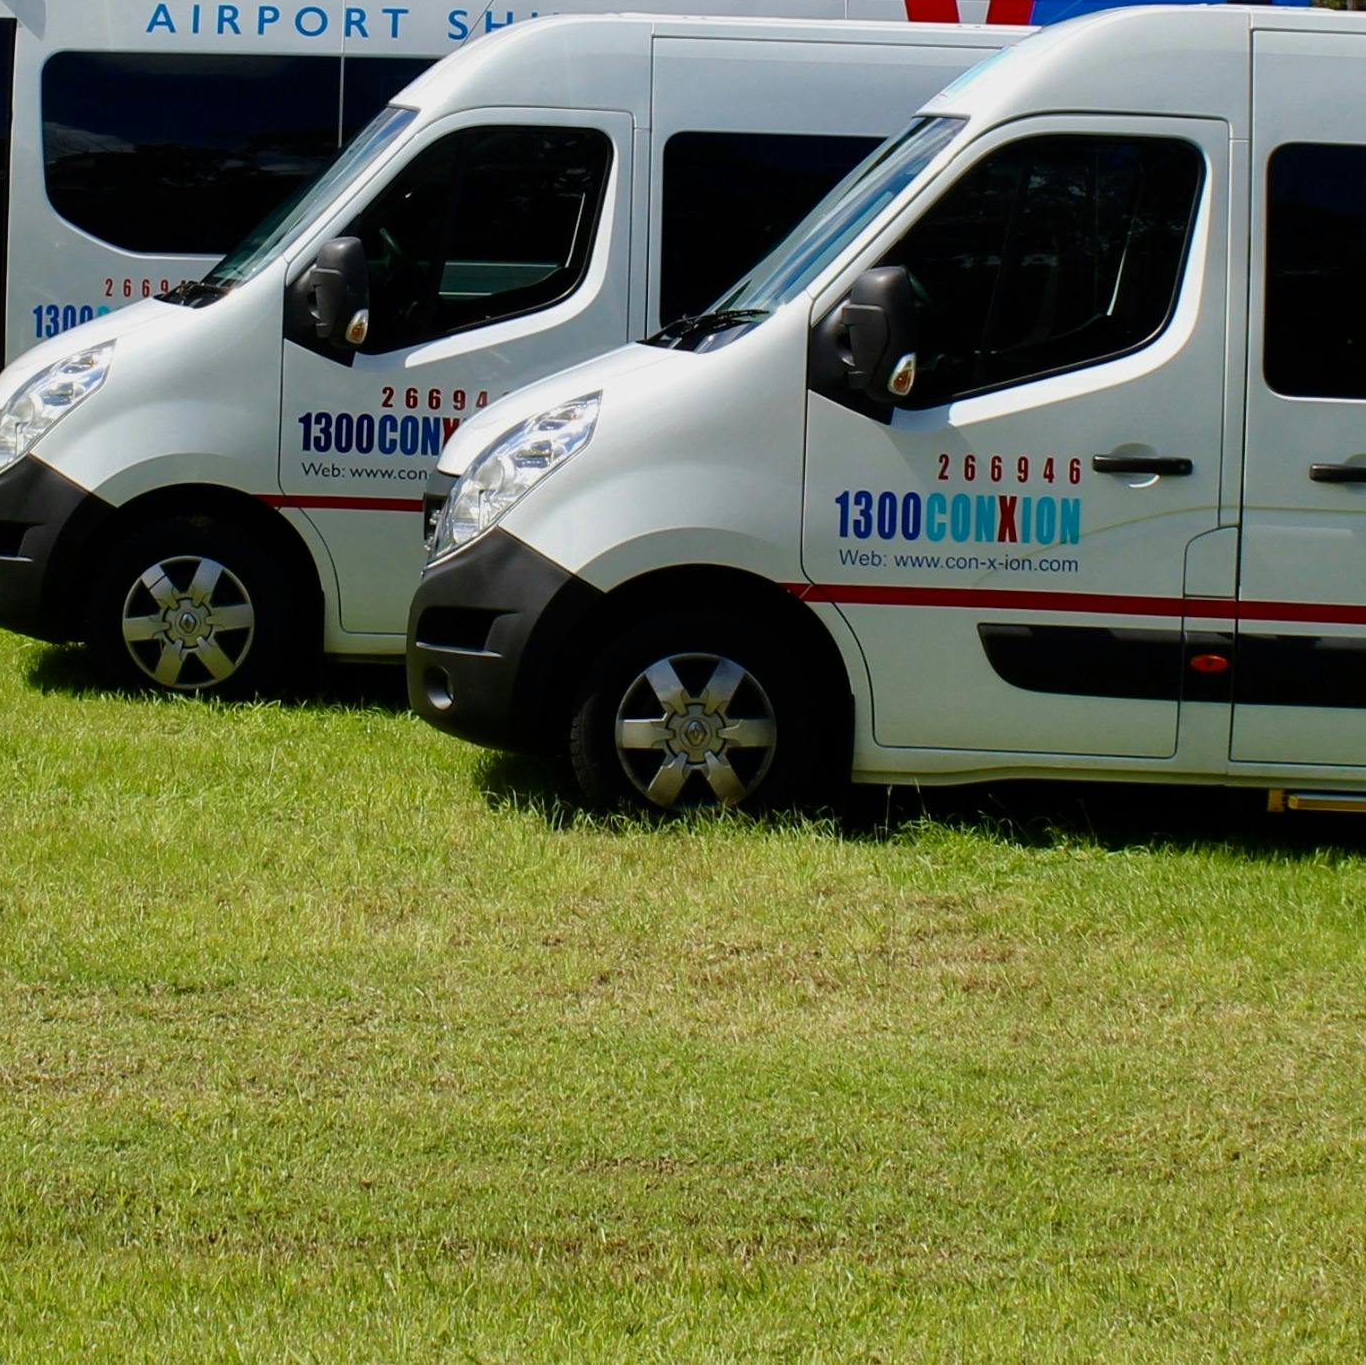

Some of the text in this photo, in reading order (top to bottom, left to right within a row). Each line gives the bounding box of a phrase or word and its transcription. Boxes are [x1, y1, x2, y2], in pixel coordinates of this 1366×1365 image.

[146, 3, 409, 38] AIRPORT
[381, 386, 509, 411] 26694
[302, 463, 345, 478] Web:
[938, 454, 1081, 484] 266946
[835, 490, 1081, 545] 1300CONXION
[839, 549, 1079, 572] Web: www.con-x-ion.com
